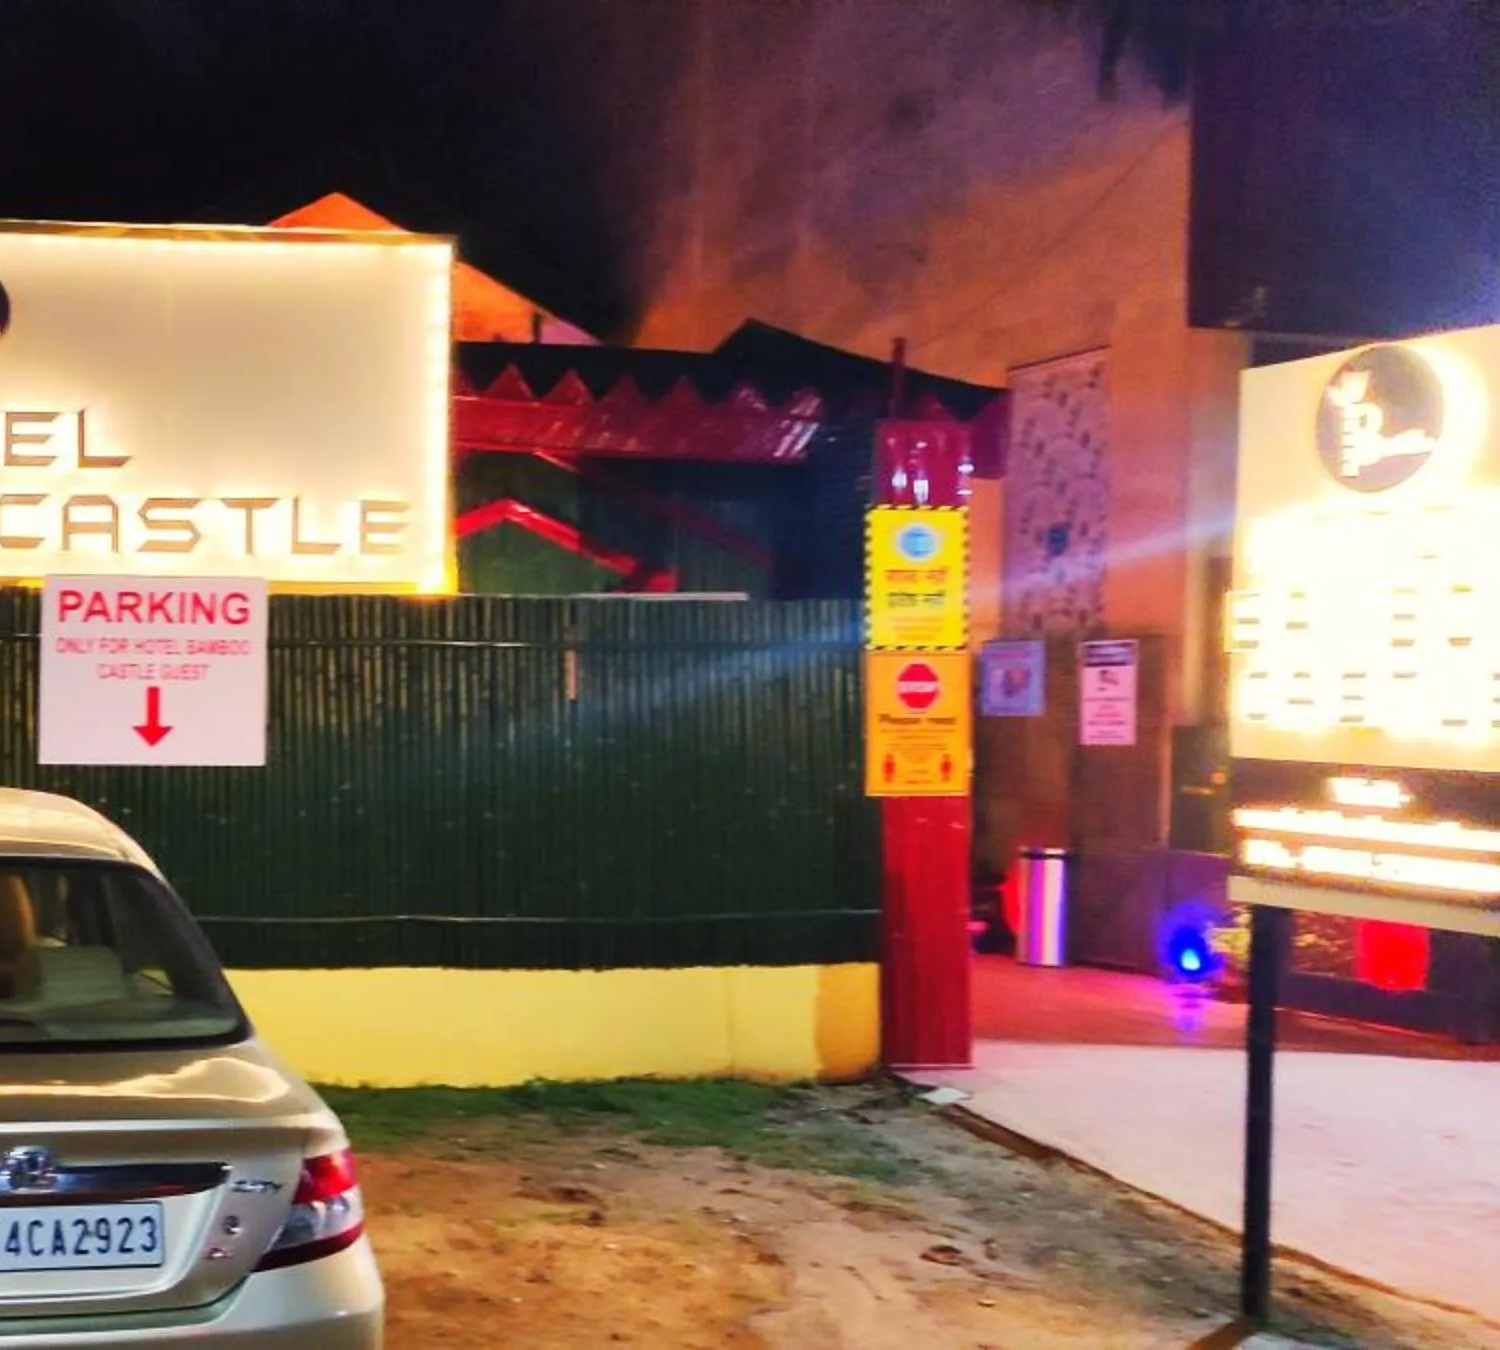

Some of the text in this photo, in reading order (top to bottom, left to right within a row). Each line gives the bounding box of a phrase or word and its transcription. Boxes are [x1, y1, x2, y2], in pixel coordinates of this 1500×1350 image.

[57, 589, 251, 625] PARKING
[55, 636, 251, 656] ONLY FOR HOTEL BAMBOO
[97, 662, 210, 681] CASTLE GUEST
